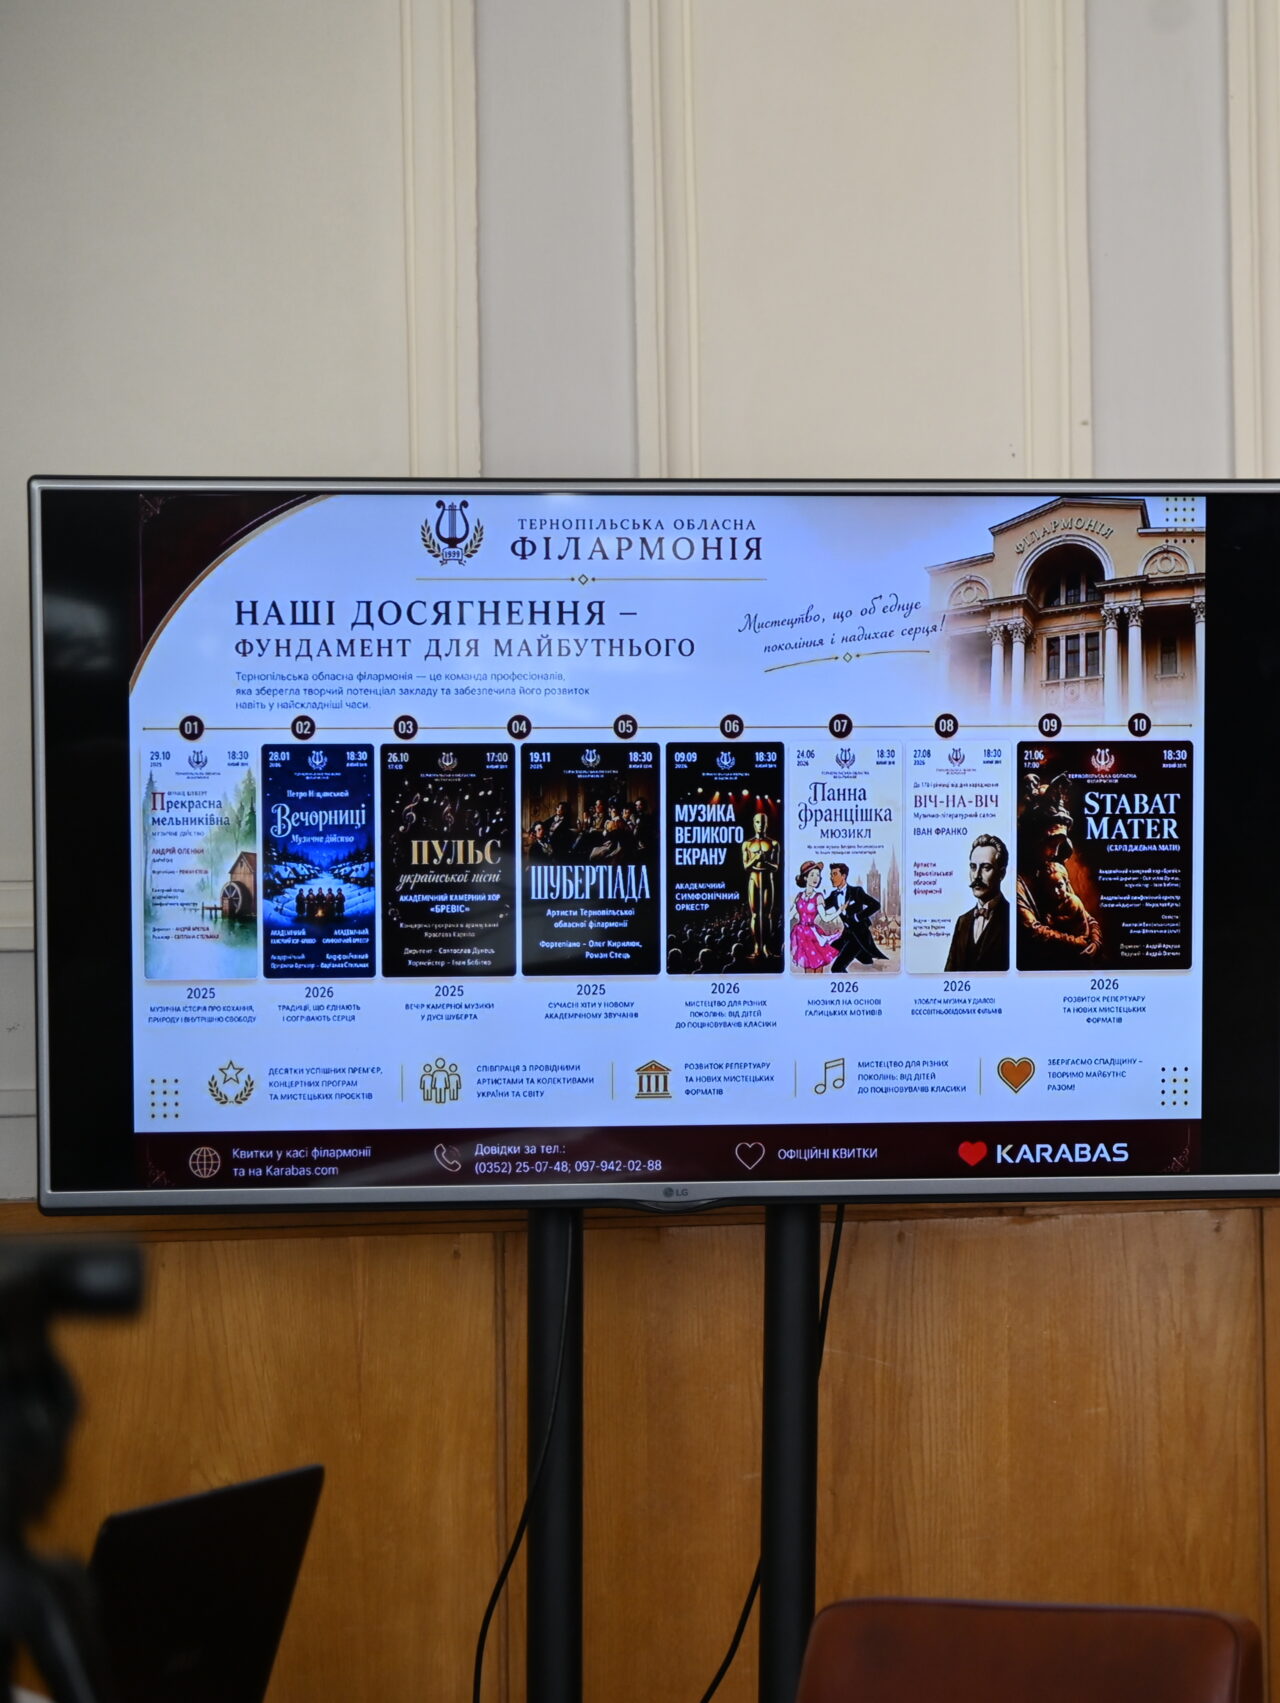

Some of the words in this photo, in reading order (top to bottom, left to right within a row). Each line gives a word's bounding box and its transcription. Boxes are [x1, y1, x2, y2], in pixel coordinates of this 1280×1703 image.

[518, 518, 665, 530] ТЕРНОПІЛЬСЬКА
[673, 518, 756, 530] ОБЛАСНА
[1015, 517, 1114, 554] ФІЛАРМОНІЯ
[510, 536, 763, 561] ФІЛАРМОНІЯ
[235, 600, 336, 626] НАШІ
[351, 600, 605, 631] ДОСЯГНЕННЯ
[738, 604, 826, 633] Мистецтво,
[832, 609, 853, 624] що
[763, 635, 825, 653] покоління
[841, 626, 895, 643] надихає
[901, 615, 946, 641] серця!
[235, 638, 412, 661] ФУНДАМЕНТ
[424, 638, 480, 661] ДЛЯ
[494, 633, 695, 657] МАЙБУТНЬОГО
[235, 671, 309, 683] Тернопільська
[312, 671, 353, 681] обласна
[356, 671, 413, 683] філармонія
[429, 673, 442, 682] це
[445, 673, 488, 682] команда
[491, 671, 566, 683] професіоналів,
[235, 688, 252, 696] яка
[255, 686, 301, 697] зберегла
[303, 686, 344, 697] творчий
[347, 687, 396, 697] потенціал
[399, 687, 438, 697] закладу
[441, 688, 451, 696] та
[454, 686, 516, 696] забезпечила
[519, 686, 542, 697] його
[544, 687, 590, 697] розвиток
[235, 701, 266, 710] навіть
[268, 702, 275, 711] у
[277, 700, 343, 711] найскладніші
[345, 702, 371, 710] часи.
[184, 721, 198, 734] 01
[296, 721, 311, 734] 02
[398, 720, 414, 734] 03
[512, 720, 527, 734] 04
[618, 720, 633, 733] 05
[724, 720, 740, 733] 06
[833, 720, 848, 732] 07
[940, 719, 954, 732] 08
[1042, 718, 1058, 732] 09
[1133, 718, 1146, 732] 10
[150, 751, 171, 760] 29.10
[227, 750, 248, 760] 18:30
[268, 751, 290, 760] 28.01
[346, 751, 368, 760] 18:30
[387, 752, 410, 762] 26.10
[486, 752, 508, 762] 17:00
[530, 752, 551, 762] 19.11
[629, 752, 652, 762] 18:30
[674, 752, 698, 762] 09.09
[755, 752, 777, 762] 18:30
[876, 749, 896, 758] 18:30
[984, 748, 1002, 758] 18:30
[1024, 750, 1044, 760] 21.06
[1162, 750, 1188, 760] 18:30
[808, 781, 867, 805] Панна
[151, 792, 222, 813] Прекрасна
[914, 794, 998, 808] ВІЧ-НА-ВІЧ
[1084, 791, 1181, 816] STABAT
[675, 804, 736, 822] МУЗИКА
[152, 814, 231, 826] мельниківна
[270, 803, 366, 838] Вечорниці
[914, 827, 932, 836] ІВАН
[934, 827, 968, 836] ФРАНКО
[1086, 816, 1180, 840] MATER
[675, 826, 744, 844] ВЕЛИКОГО
[410, 838, 501, 865] ПУЛЬС
[675, 848, 728, 866] ЕКРАНУ
[395, 870, 468, 891] української
[530, 865, 650, 902] ШУБЕРТІАДА
[675, 882, 726, 890] АКАДЕМІЧНИЙ
[449, 892, 486, 902] КАМЕРНИЙ
[487, 894, 500, 902] ХОР
[675, 892, 740, 900] СИМФОНІЧНИЙ
[546, 908, 578, 918] Артисти
[580, 908, 635, 918] Тернопільської
[585, 951, 608, 959] Роман
[576, 984, 606, 996] 2025
[710, 982, 740, 994] 2026
[830, 982, 858, 993] 2026
[943, 980, 971, 992] 2026
[1090, 978, 1119, 990] 2026
[186, 987, 216, 999] 2025
[304, 986, 334, 998] 2026
[434, 985, 464, 997] 2025
[528, 1064, 581, 1073] ПРОВІДНИМИ
[684, 1062, 724, 1070] РОЗВИТОК
[725, 1062, 771, 1070] РЕПЕРТУАРУ
[858, 1060, 904, 1069] МИСТЕЦТВО
[904, 1060, 920, 1068] ДЛЯ
[268, 1067, 304, 1076] ДЕСЯТКИ
[305, 1066, 346, 1075] УСПІШНИХ
[268, 1080, 320, 1089] КОНЦЕРТНИХ
[321, 1079, 358, 1088] ПРОГРАМ
[476, 1077, 524, 1086] АРТИСТАМИ
[526, 1077, 535, 1085] ТА
[536, 1076, 594, 1085] КОЛЕКТИВАМИ
[696, 1075, 722, 1083] НОВИХ
[723, 1074, 774, 1084] МИСТЕЦЬКИХ
[269, 1093, 279, 1101] ТА
[280, 1092, 333, 1102] МИСТЕЦЬКИХ
[335, 1092, 373, 1100] ПРОЄКТІВ
[476, 1089, 510, 1098] УКРАЇНИ
[511, 1090, 522, 1098] ТА
[522, 1090, 544, 1098] СВІТУ
[684, 1088, 724, 1096] ФОРМАТІВ
[232, 1148, 274, 1159] Квитки
[276, 1150, 283, 1161] у
[285, 1147, 309, 1159] касі
[311, 1146, 372, 1160] філармонії
[474, 1143, 521, 1157] Довідки
[524, 1146, 536, 1155] за
[540, 1145, 566, 1155] тел.:
[777, 1146, 830, 1162] ОФІЦІЙНІ
[832, 1148, 878, 1159] КВИТКИ
[996, 1142, 1129, 1164] KARABAS
[232, 1168, 246, 1177] та
[249, 1168, 262, 1177] на
[265, 1164, 339, 1177] Karabas.com
[474, 1162, 512, 1175] (0352)
[515, 1161, 572, 1175] 25-07-48;
[574, 1160, 662, 1172] 097-942-02-88
[676, 1188, 689, 1197] LG
